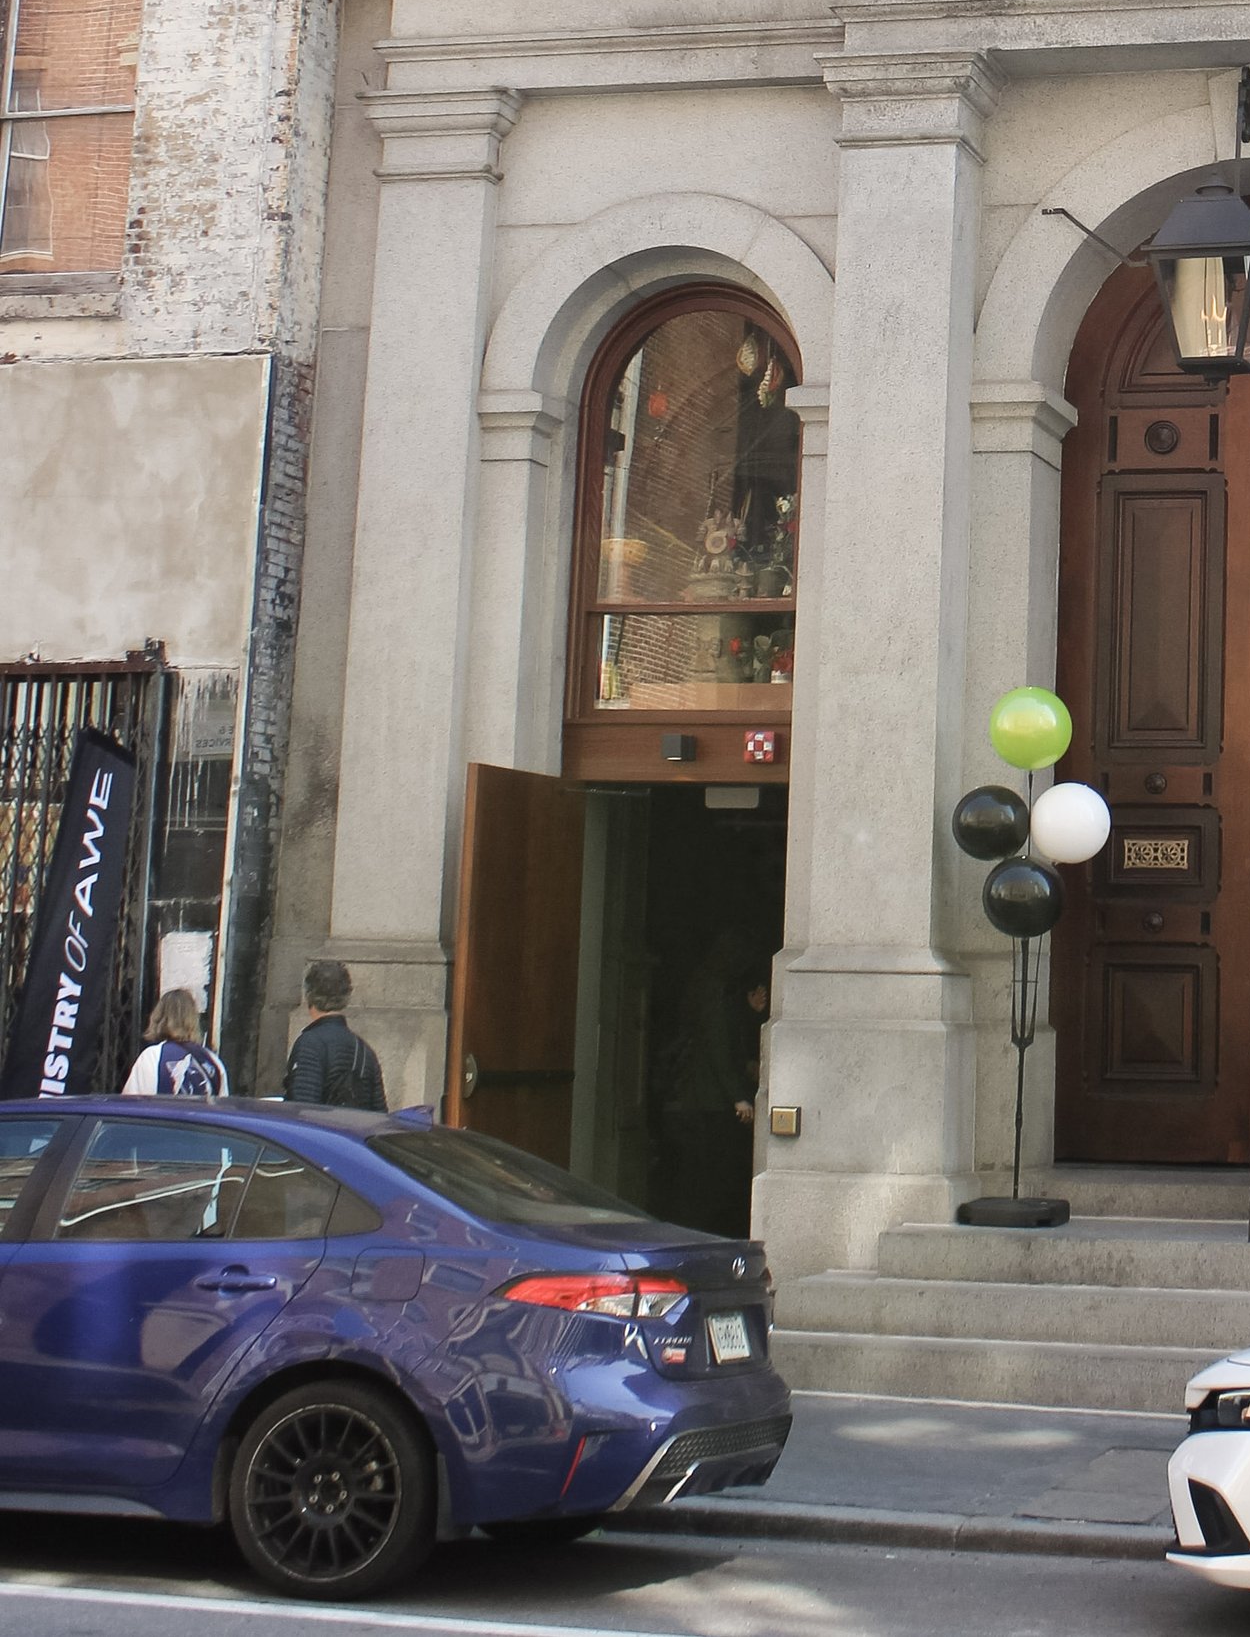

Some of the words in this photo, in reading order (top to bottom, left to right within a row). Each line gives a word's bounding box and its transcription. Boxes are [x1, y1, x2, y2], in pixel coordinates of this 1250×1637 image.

[75, 767, 113, 917] AWE
[64, 910, 89, 972] OF
[38, 971, 82, 1100] ISTRY
